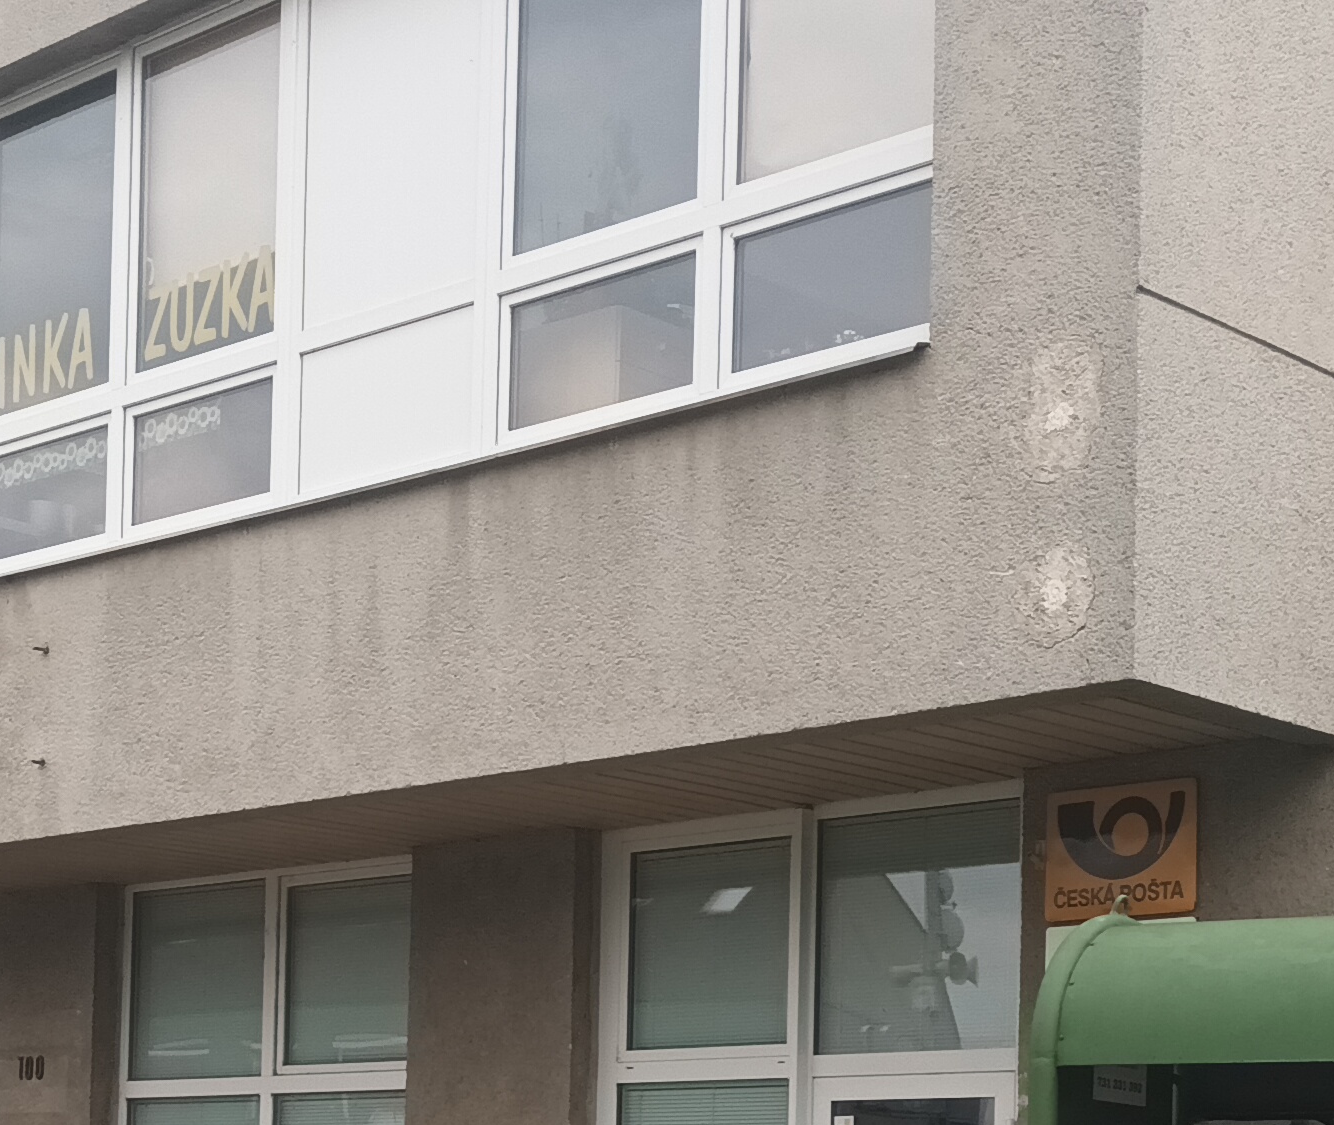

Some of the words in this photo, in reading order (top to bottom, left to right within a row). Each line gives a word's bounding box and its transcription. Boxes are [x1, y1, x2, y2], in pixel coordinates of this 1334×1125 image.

[144, 245, 275, 362] ZUZKA
[1054, 882, 1115, 909] ČESKÁ
[1119, 878, 1184, 909] POŠTA
